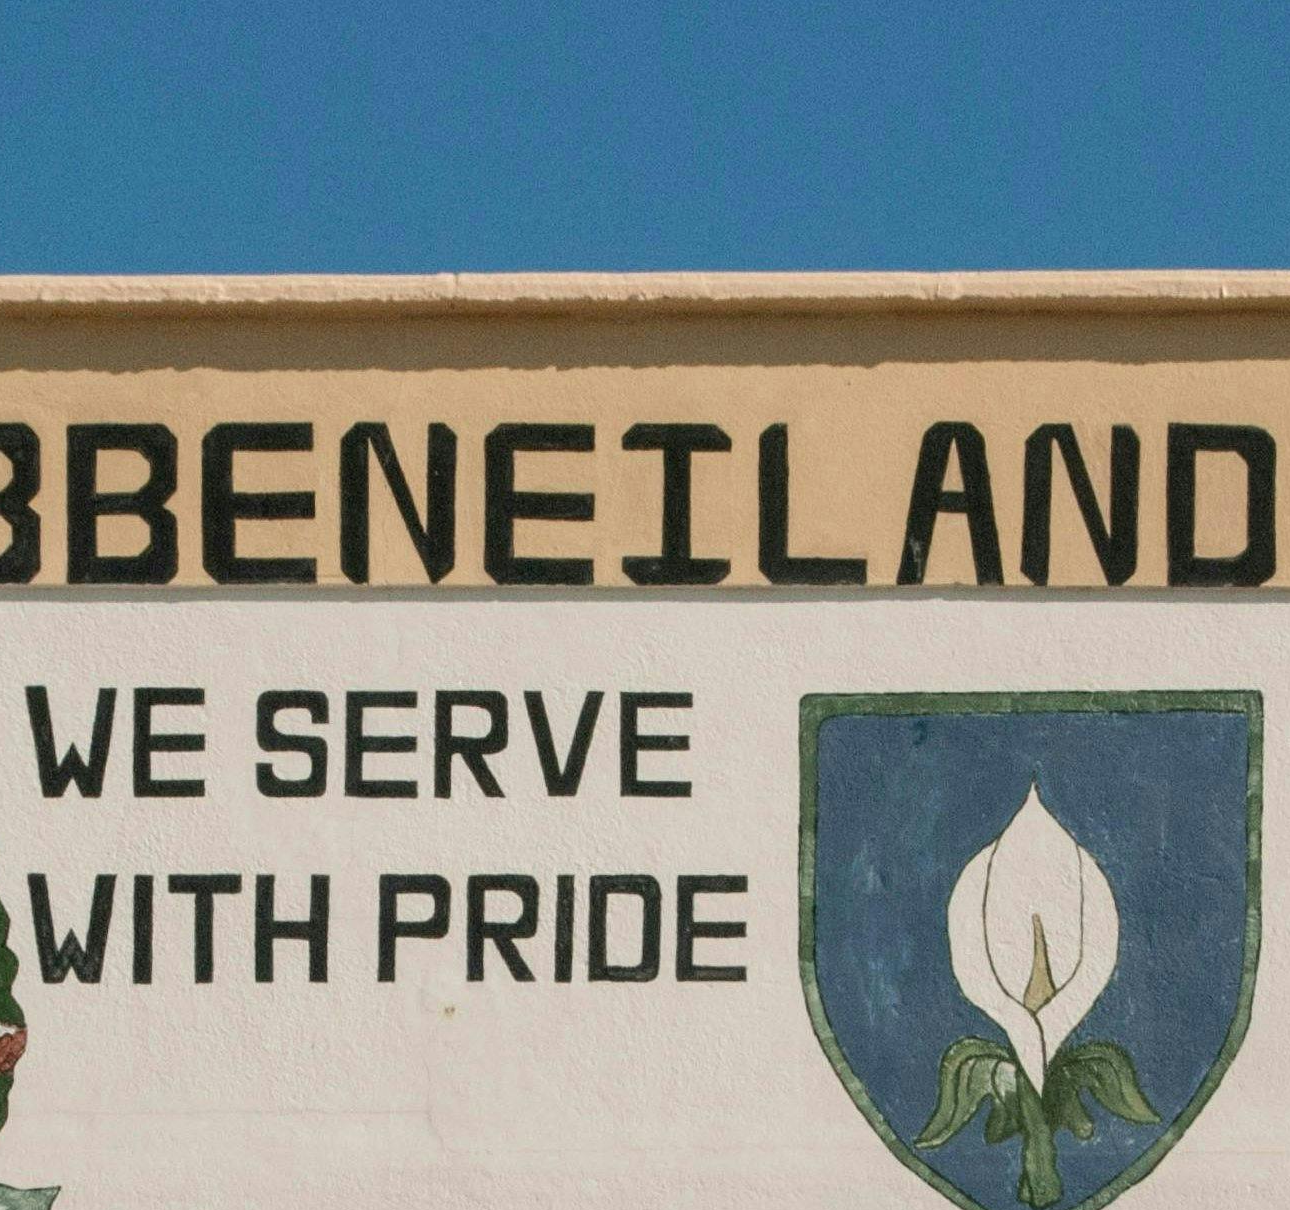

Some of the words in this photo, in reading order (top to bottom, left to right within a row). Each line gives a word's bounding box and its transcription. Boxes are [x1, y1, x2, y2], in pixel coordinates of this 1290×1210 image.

[25, 685, 206, 798] WE
[256, 690, 693, 799] SERVE
[33, 873, 331, 985] WITH
[377, 874, 748, 983] PRIDE
